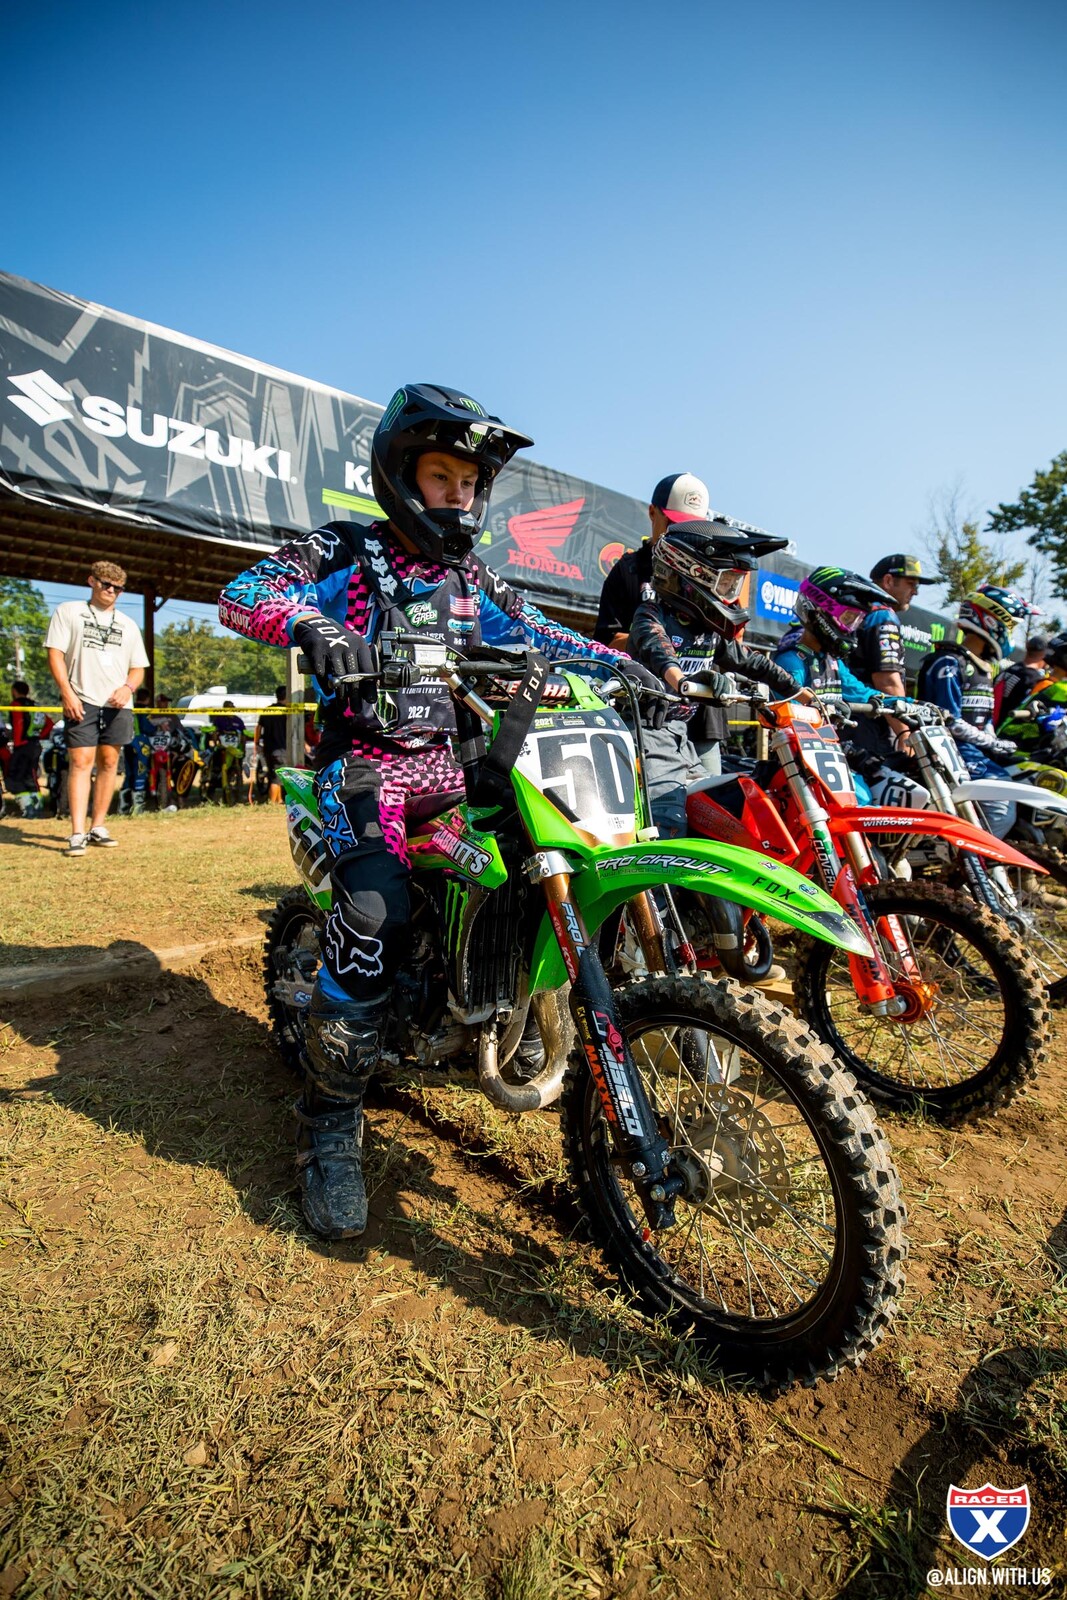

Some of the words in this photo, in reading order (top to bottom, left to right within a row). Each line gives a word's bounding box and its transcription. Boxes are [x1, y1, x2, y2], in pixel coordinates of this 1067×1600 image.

[82, 396, 292, 483] SUZUKI
[507, 549, 585, 581] HONDA
[405, 602, 432, 615] TEAM
[764, 603, 796, 617] RACI
[805, 585, 836, 612] 100%
[411, 611, 438, 624] GREEN
[988, 603, 1019, 630] 100%
[308, 619, 350, 648] FOX
[522, 662, 544, 703] FOX
[534, 717, 554, 727] 2021
[536, 733, 636, 823] 50
[596, 855, 636, 870] PRO
[637, 854, 730, 875] CIRCUIT
[752, 877, 796, 900] FOX
[561, 902, 584, 943] PRO
[584, 1044, 617, 1122] MAXXIS
[598, 1048, 615, 1096] Performance
[612, 1097, 626, 1131] Products
